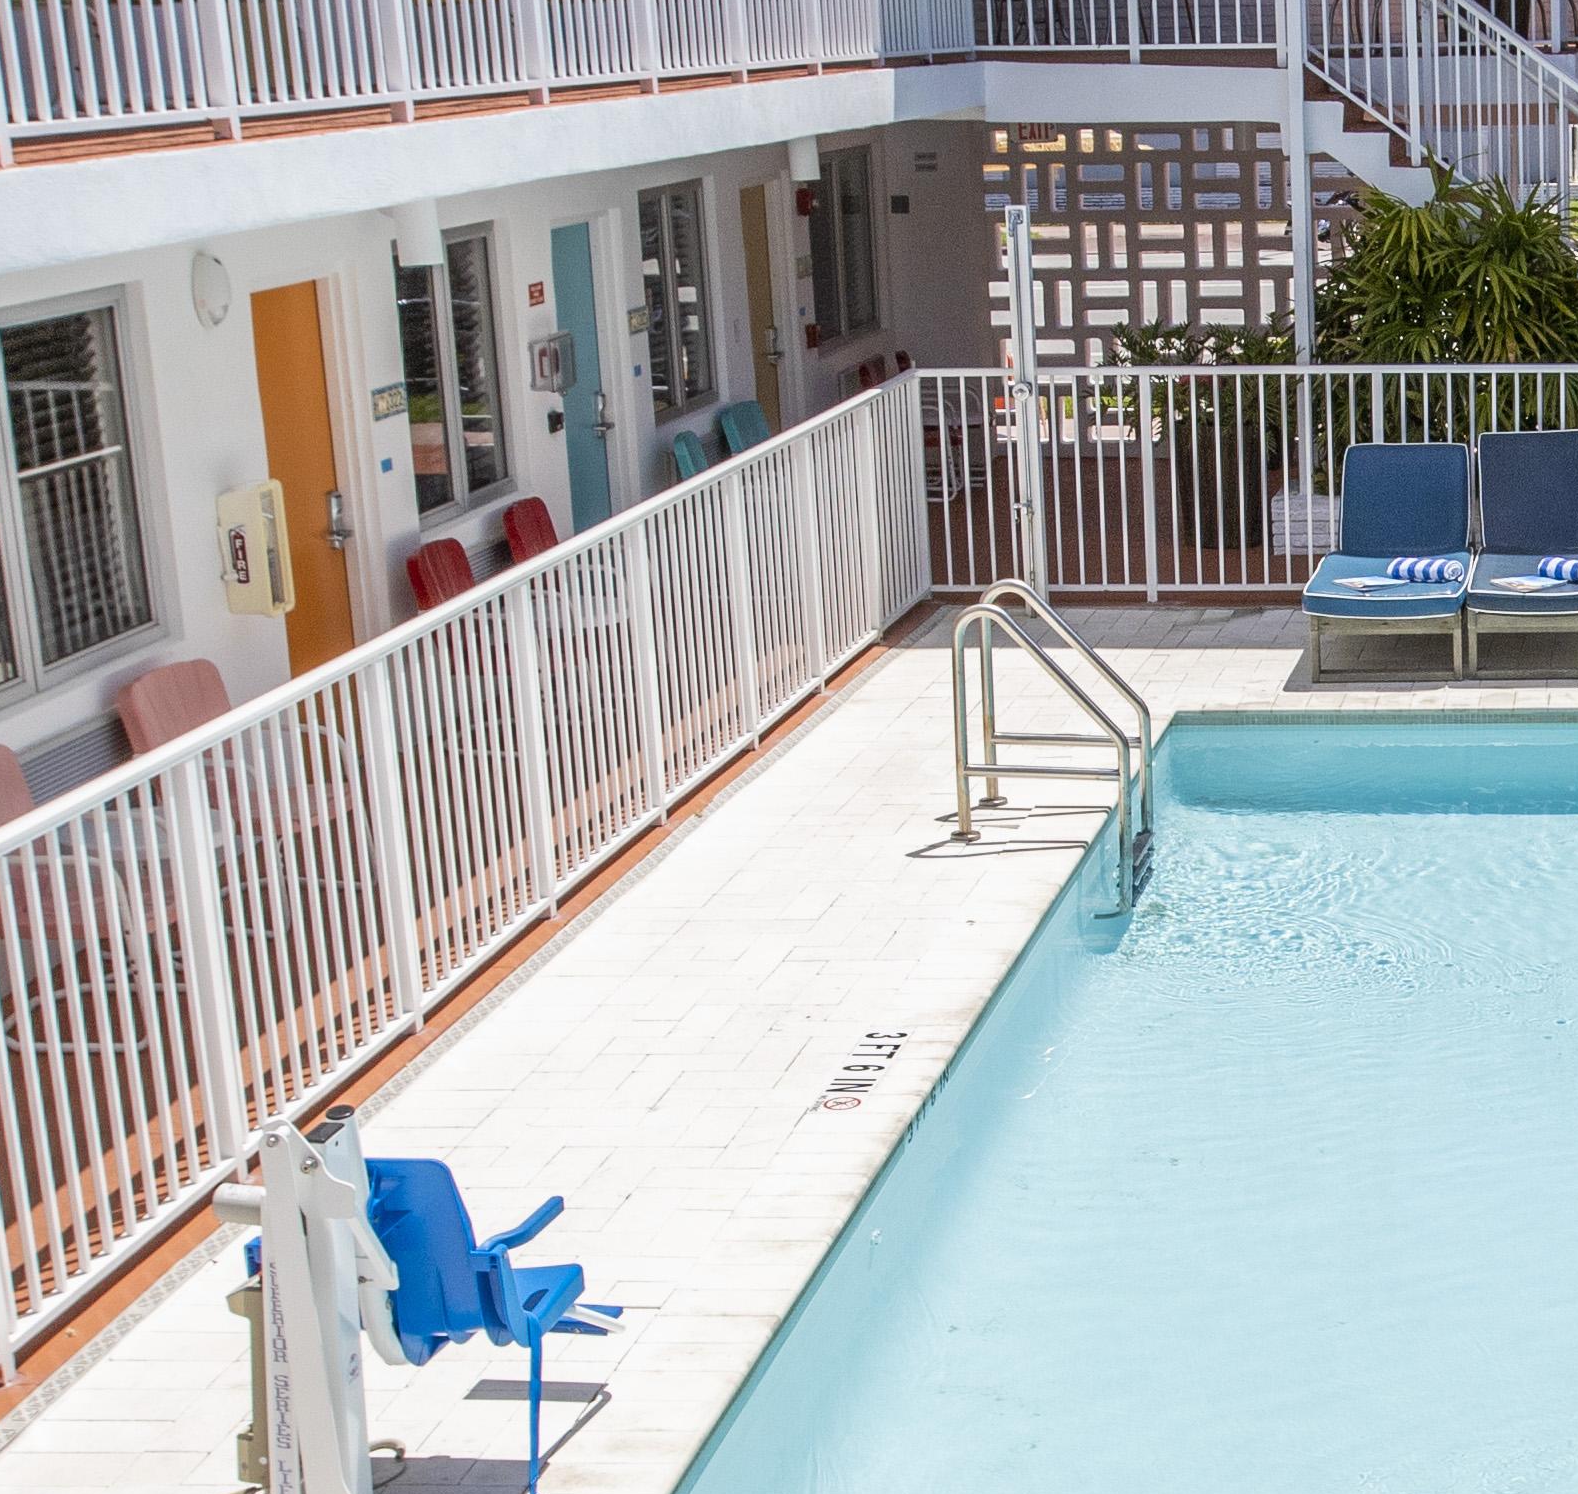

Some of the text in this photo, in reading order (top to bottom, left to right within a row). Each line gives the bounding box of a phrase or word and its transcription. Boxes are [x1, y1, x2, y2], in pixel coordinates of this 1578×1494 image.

[235, 538, 247, 581] FIRE
[852, 1044, 902, 1059] FT
[842, 1064, 885, 1072] 6
[825, 1078, 878, 1093] IN
[274, 1375, 291, 1449] SERIES
